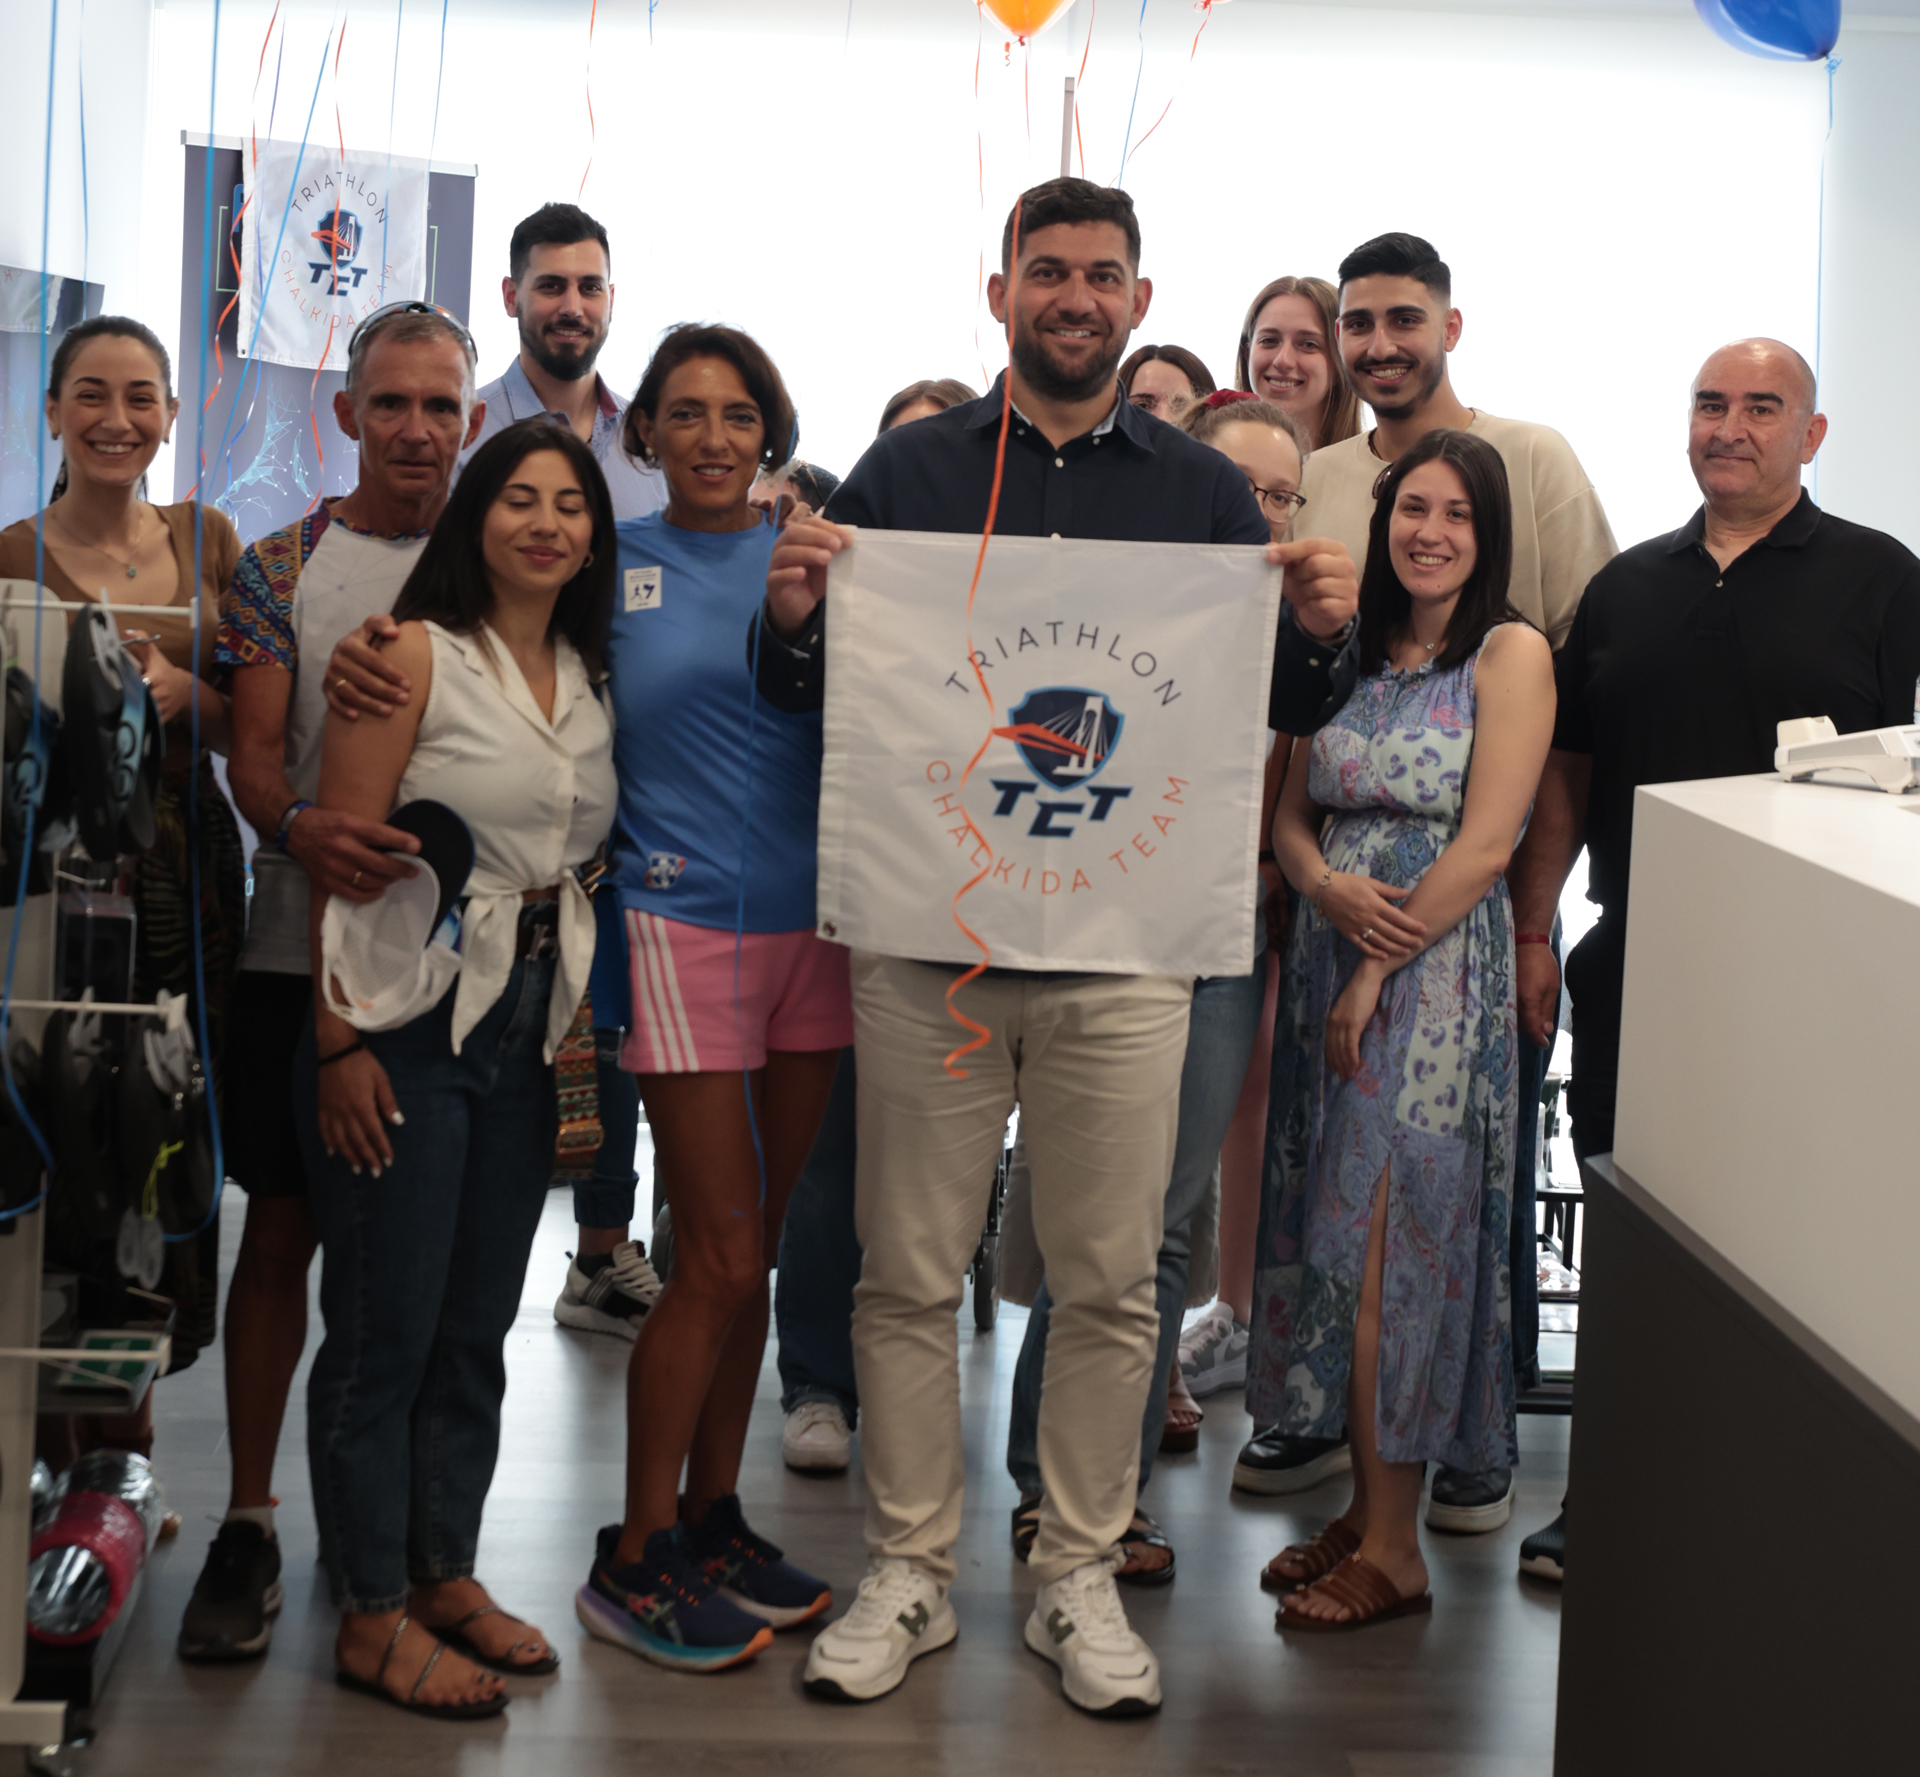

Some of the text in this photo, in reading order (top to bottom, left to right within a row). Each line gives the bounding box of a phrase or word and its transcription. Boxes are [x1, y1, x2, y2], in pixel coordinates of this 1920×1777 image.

[291, 171, 389, 224] TRIATHLON
[281, 249, 393, 329] CHALKIDA TEAM
[945, 620, 1182, 707] TRIATHLON
[925, 759, 1190, 896] CHALKIDA TEAM
[988, 778, 1134, 839] TCT
